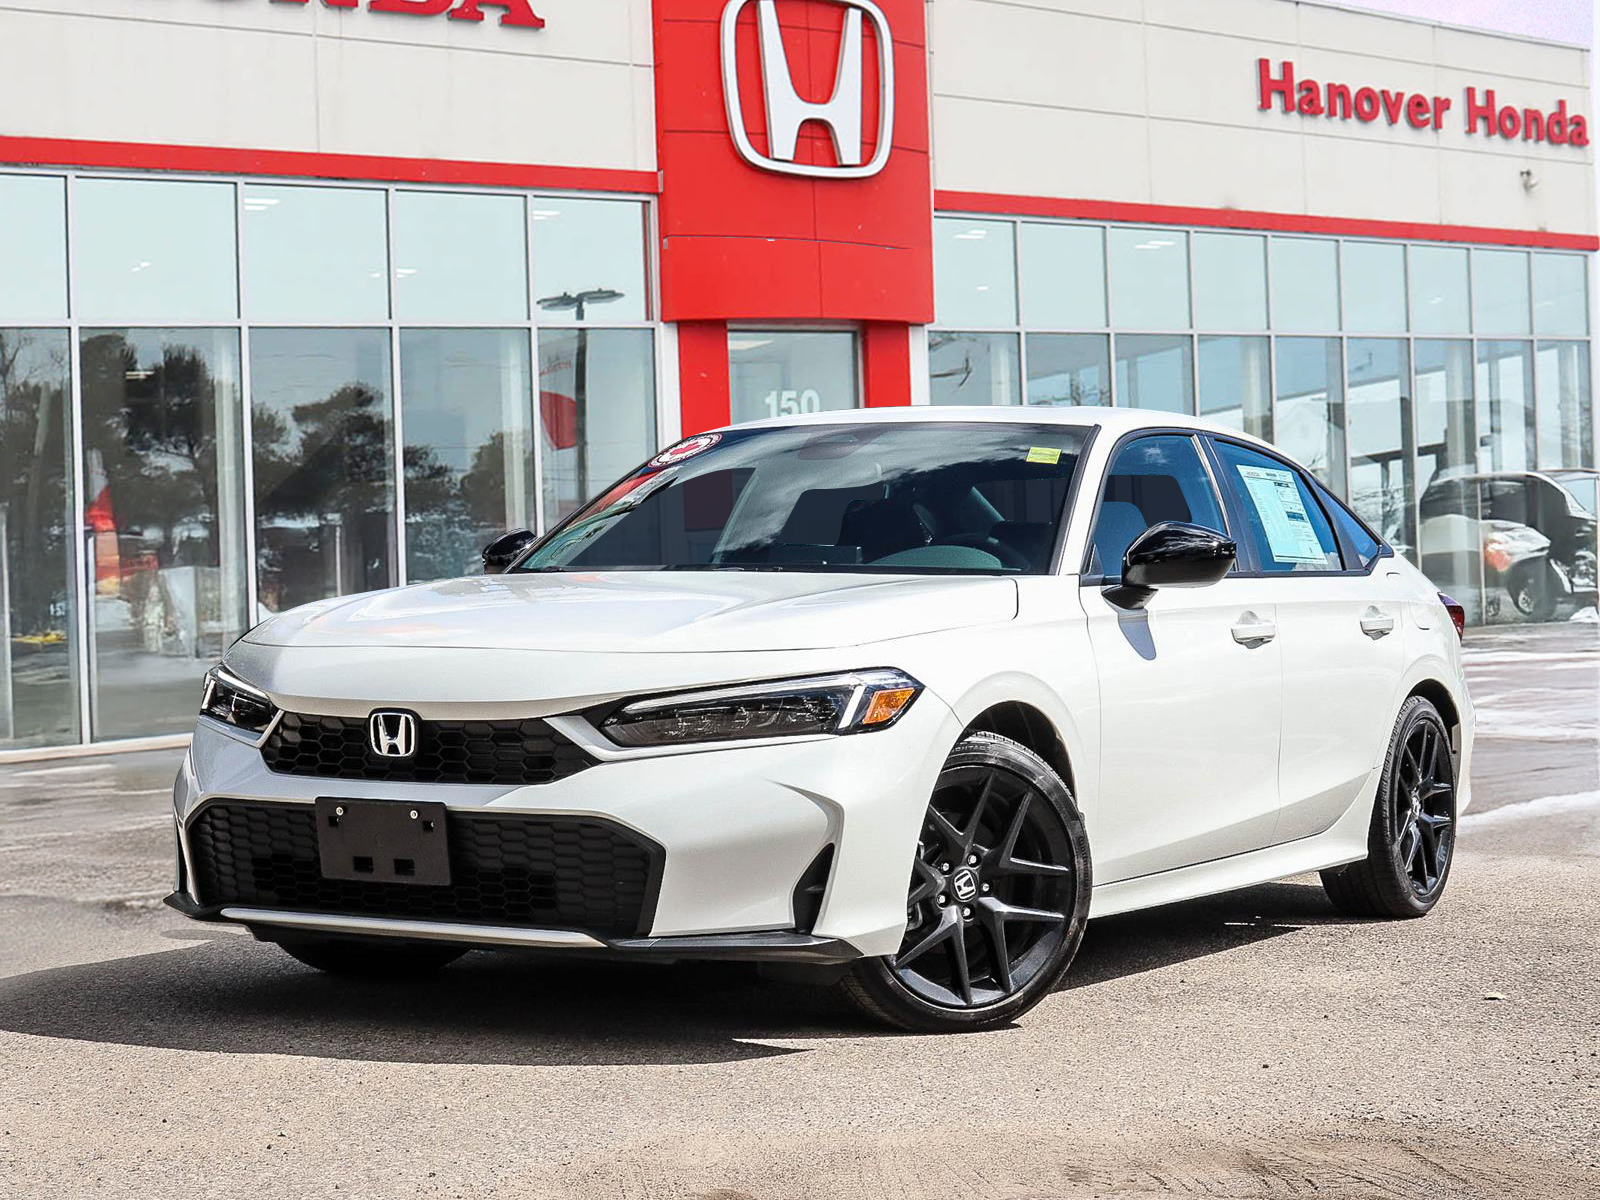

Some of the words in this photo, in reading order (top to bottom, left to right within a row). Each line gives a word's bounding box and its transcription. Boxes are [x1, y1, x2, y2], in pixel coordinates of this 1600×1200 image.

[1256, 58, 1452, 130] Hanover
[1465, 86, 1590, 147] Honda
[764, 388, 820, 417] 150
